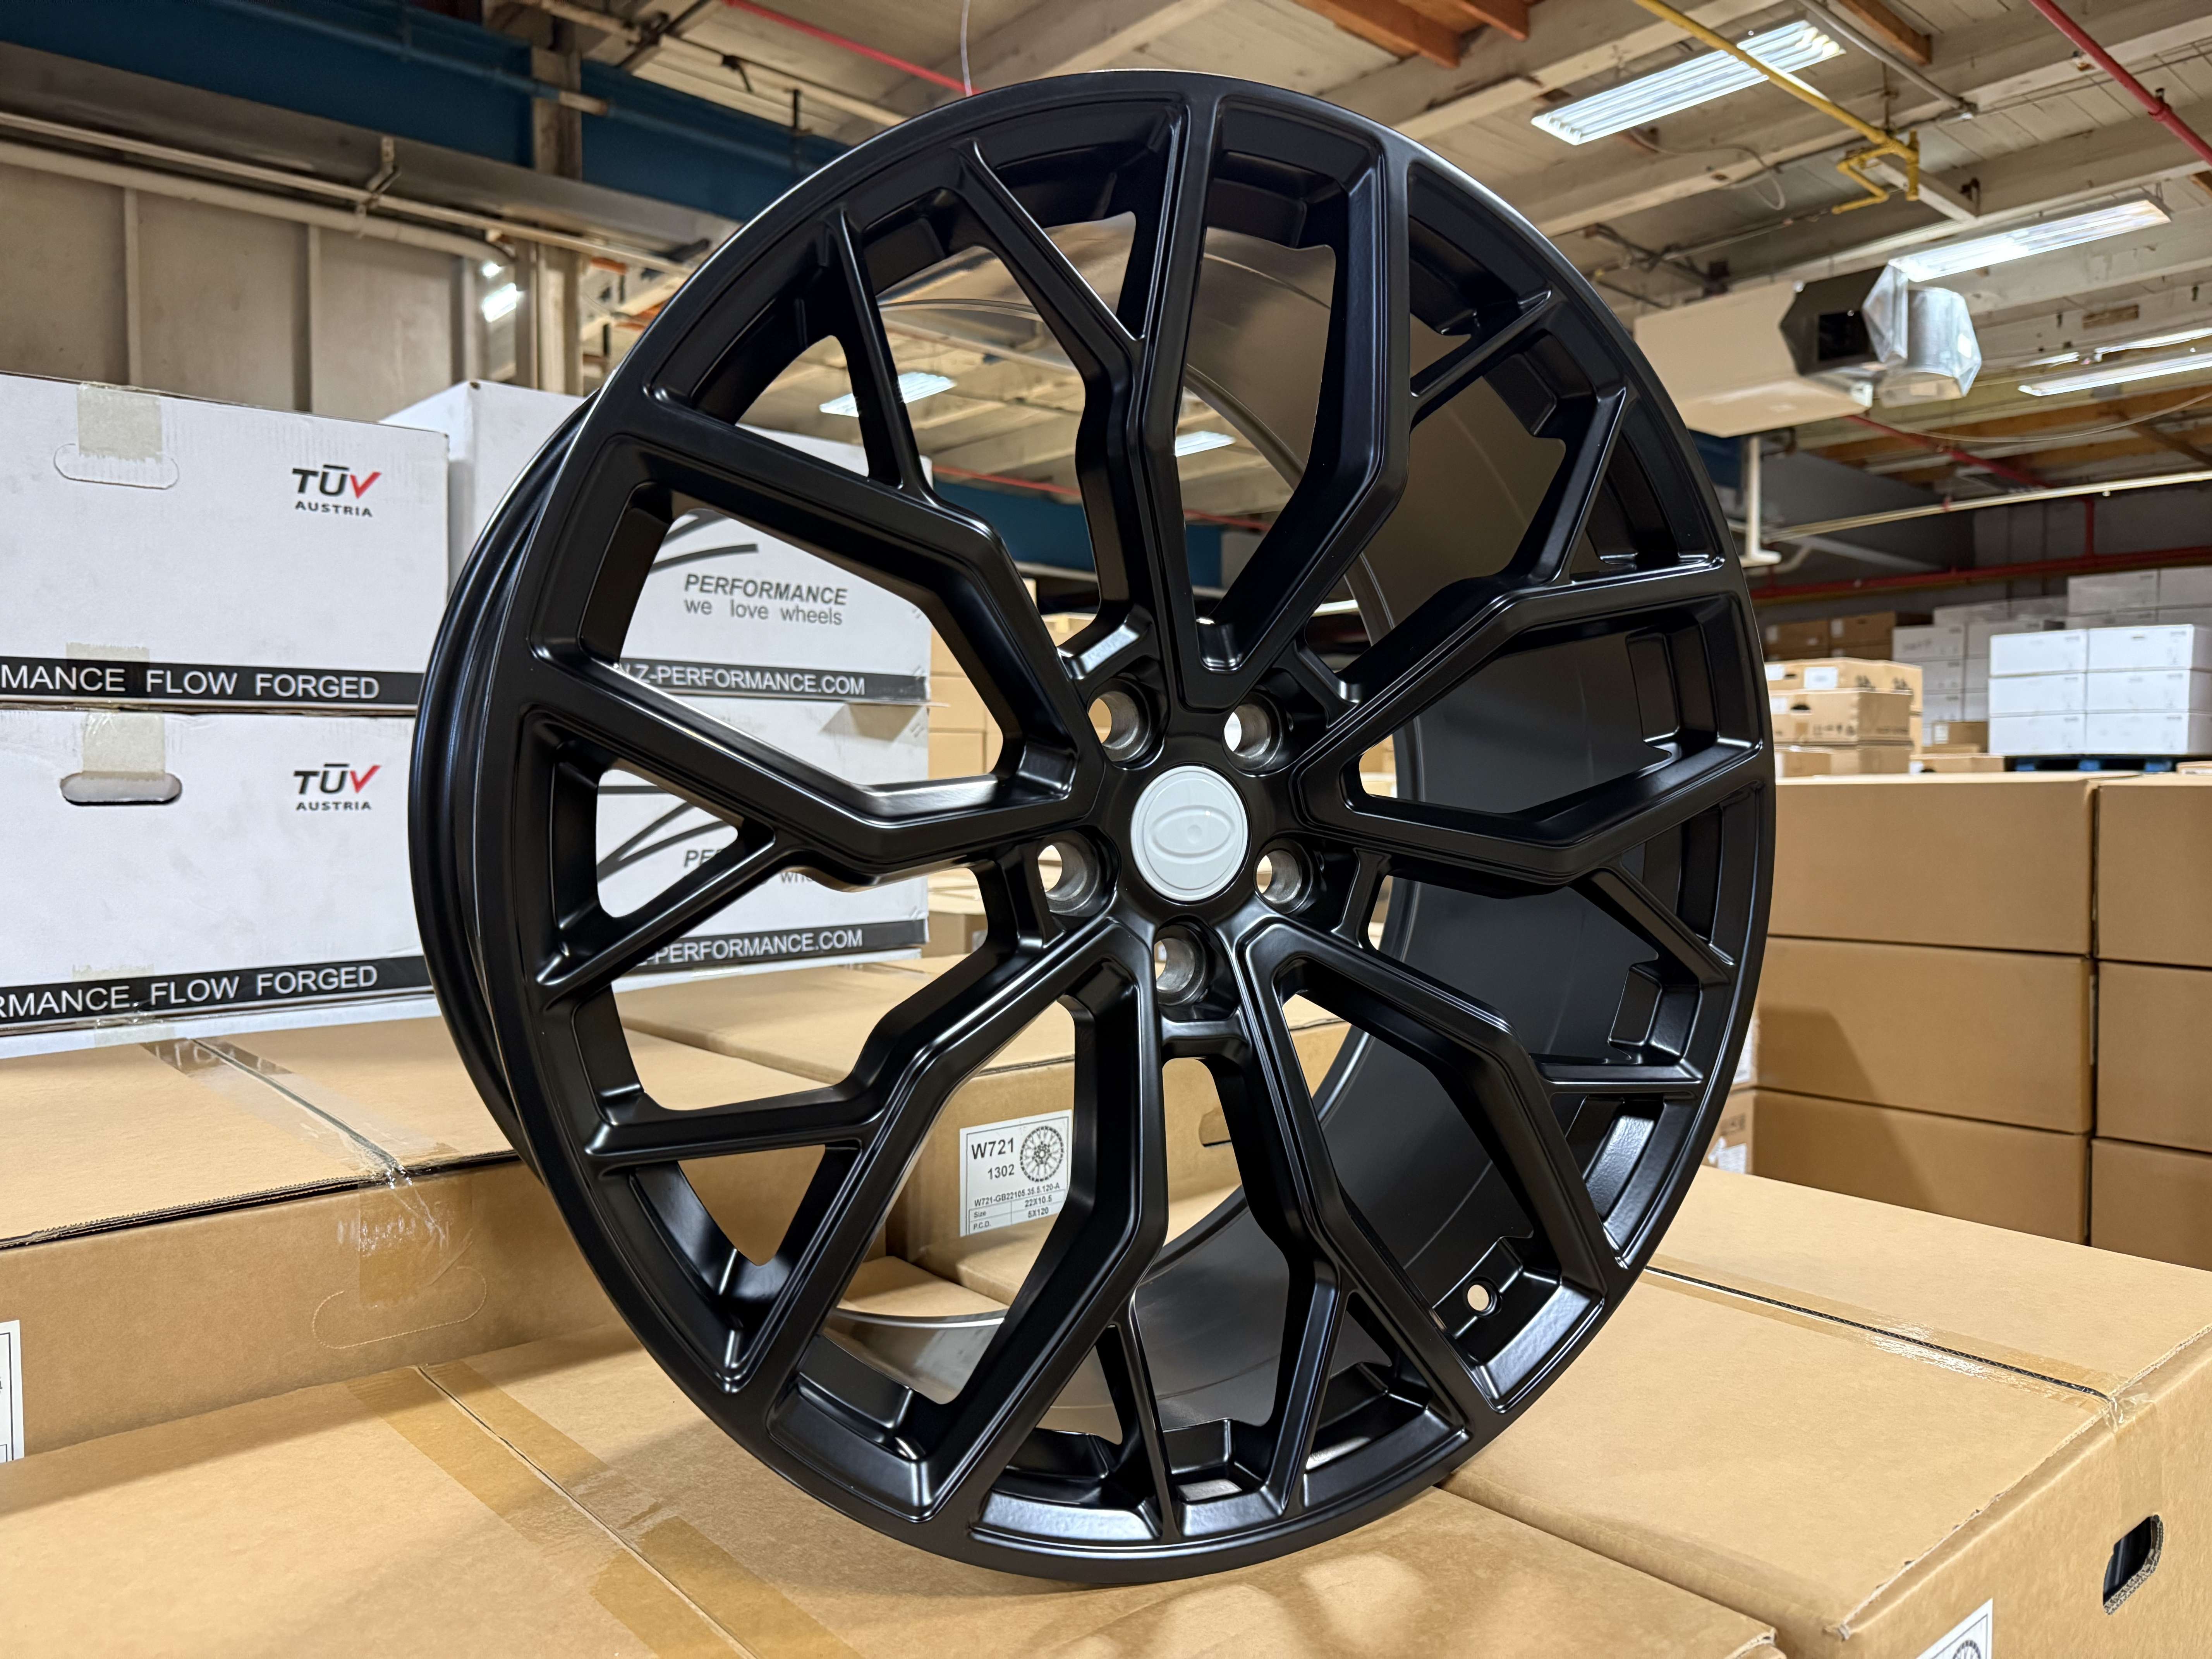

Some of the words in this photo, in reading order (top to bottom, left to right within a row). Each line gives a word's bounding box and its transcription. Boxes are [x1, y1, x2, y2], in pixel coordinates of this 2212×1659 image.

[295, 500, 373, 518] AUSTRIA
[684, 574, 848, 606] PERFORMANCE
[684, 598, 712, 615] we
[730, 599, 769, 620] love
[780, 605, 843, 625] wheels
[146, 670, 237, 694] FLOW
[256, 673, 380, 699] FORGED
[296, 801, 372, 811] AUSTRIA
[151, 976, 239, 1005] FLOW
[257, 965, 378, 996] FORGED
[971, 1137, 1013, 1159] W721
[988, 1164, 1015, 1180] 1302
[974, 1211, 987, 1219] Size
[973, 1221, 991, 1230] P.C.D.
